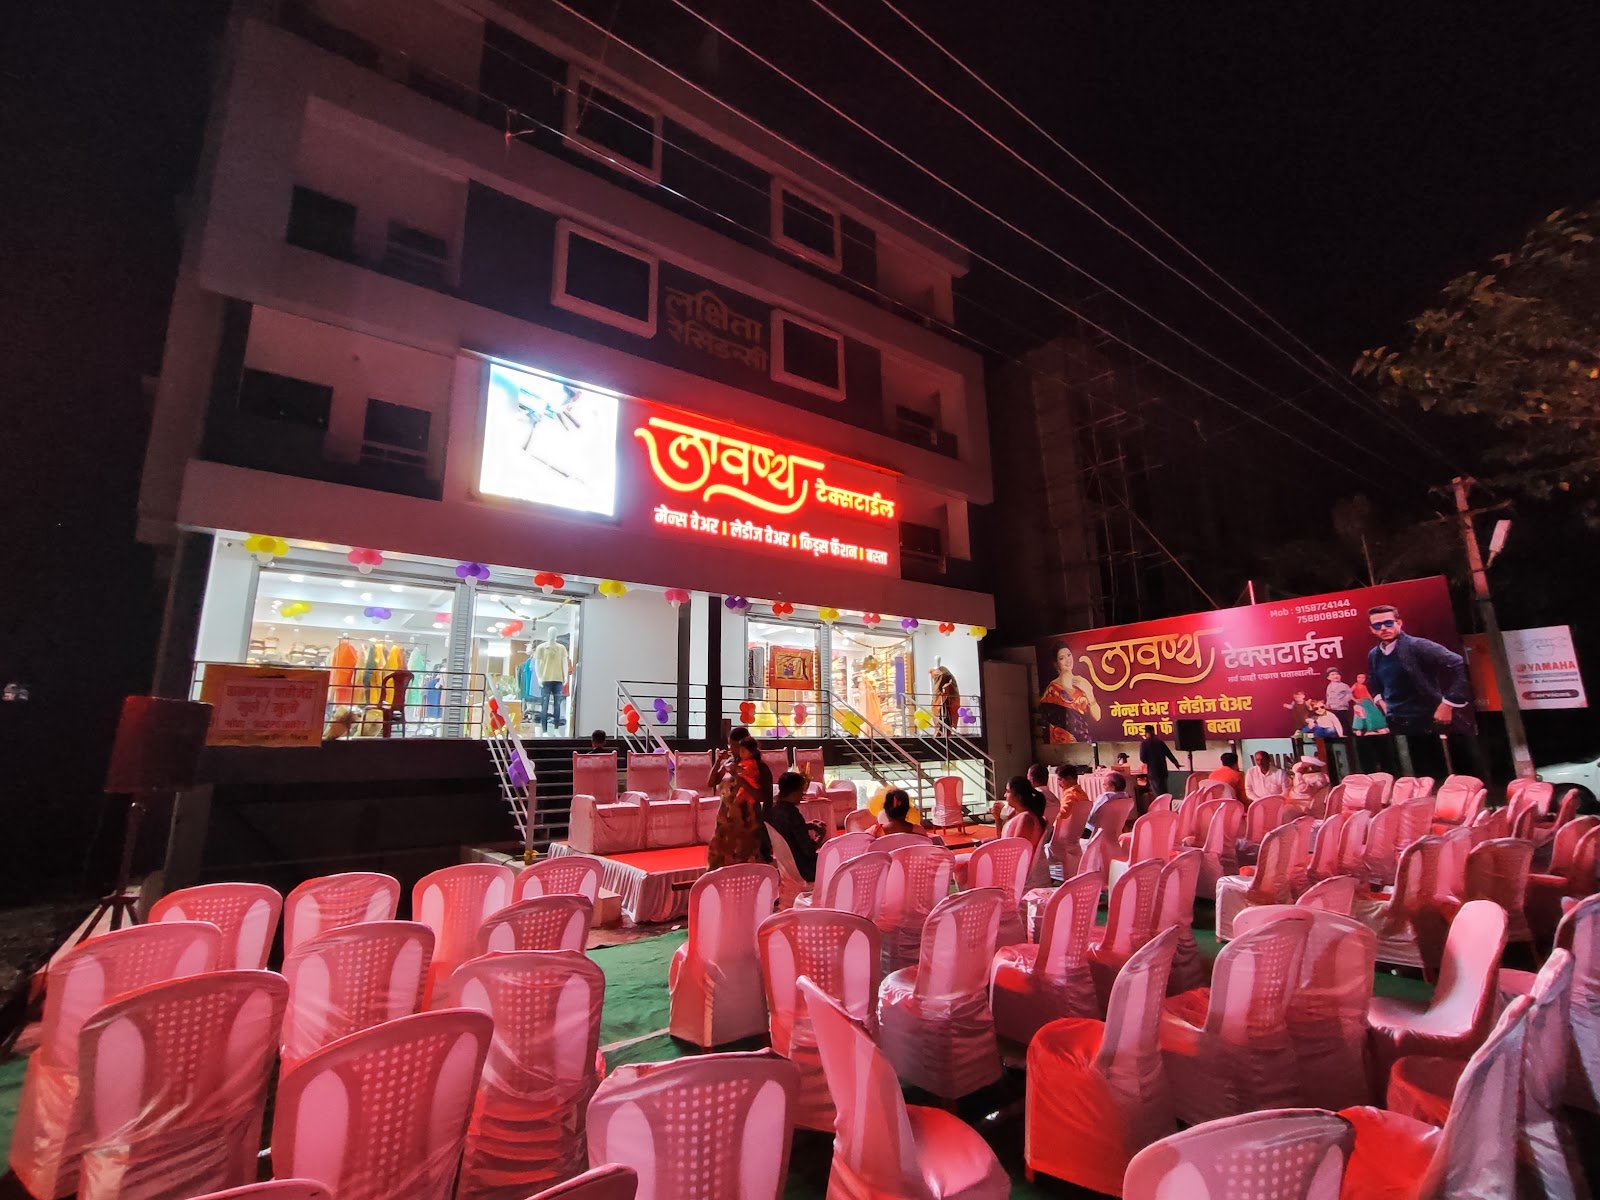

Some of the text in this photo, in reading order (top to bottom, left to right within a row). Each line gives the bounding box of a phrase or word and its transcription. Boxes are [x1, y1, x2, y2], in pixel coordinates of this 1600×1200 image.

[814, 478, 895, 518] टेक्सटाईल
[690, 511, 719, 535] वेअर
[730, 518, 763, 543] लेडीज
[764, 525, 790, 548] वेअर
[866, 548, 888, 566] बस्ता
[1270, 609, 1290, 619] Mob
[1296, 599, 1351, 616] 9158724144
[1297, 608, 1358, 624] 7588088360
[1221, 631, 1344, 669] टेक्सटाईल
[1527, 661, 1576, 672] YAMAHA
[1141, 699, 1170, 717] वेअर
[1177, 695, 1217, 714] लेडीज
[1218, 694, 1253, 712] वेअर
[1205, 718, 1241, 734] बस्ता
